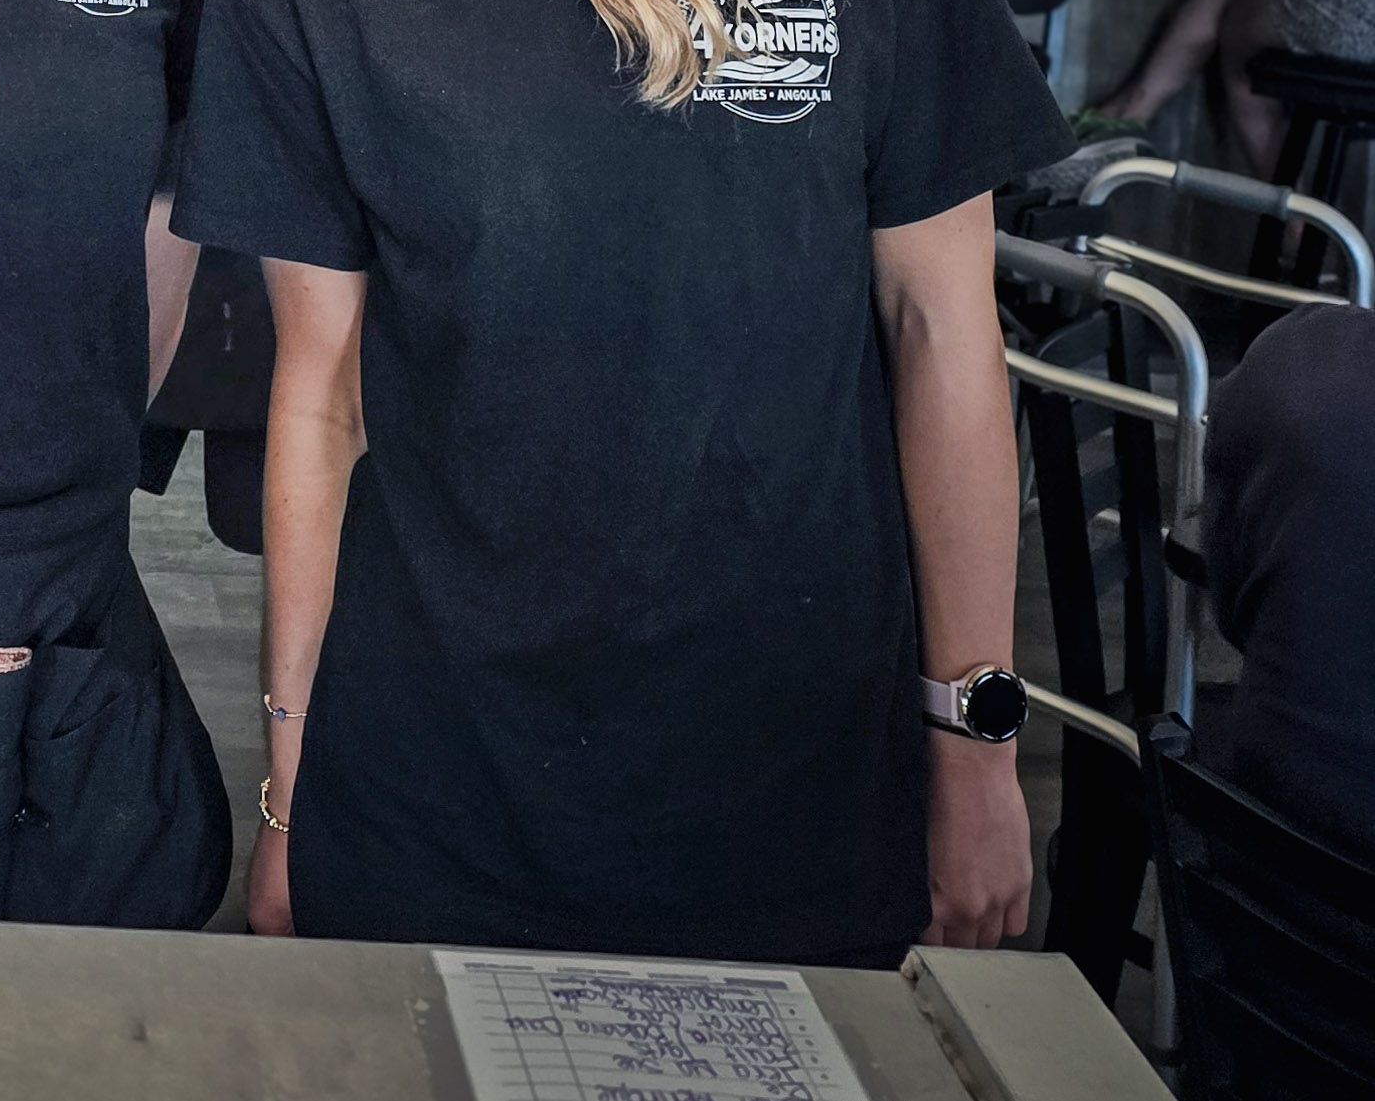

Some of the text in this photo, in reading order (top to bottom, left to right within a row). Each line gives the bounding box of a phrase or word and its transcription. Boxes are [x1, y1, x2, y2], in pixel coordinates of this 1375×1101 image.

[693, 89, 725, 101] LAKE
[728, 89, 767, 101] JAMES
[777, 89, 820, 103] ANGOLA,
